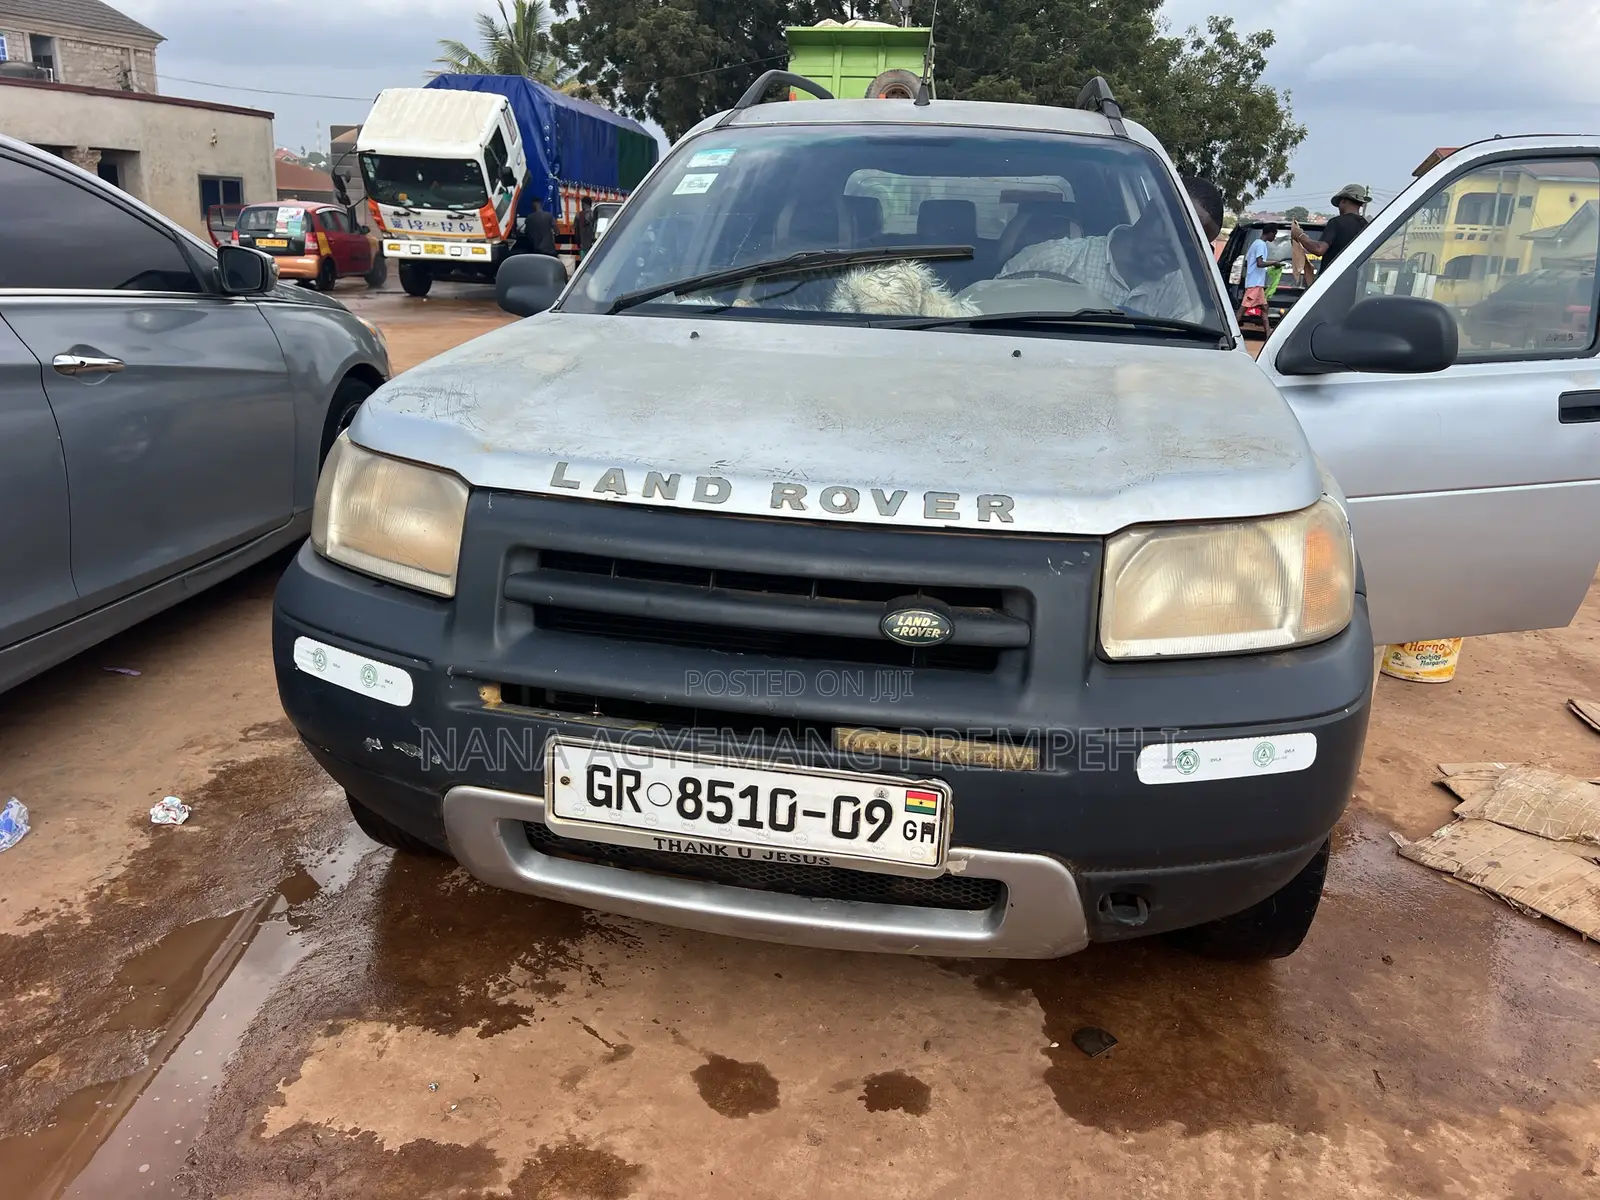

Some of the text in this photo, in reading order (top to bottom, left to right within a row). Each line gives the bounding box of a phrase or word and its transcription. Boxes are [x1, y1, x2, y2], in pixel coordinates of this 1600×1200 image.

[549, 461, 1015, 522] LAND ROVER
[897, 615, 931, 626] LAND
[900, 627, 941, 638] ROVER
[586, 765, 893, 842] GR 8510-09
[902, 820, 936, 844] GH
[653, 838, 830, 866] THANK U JESUS
